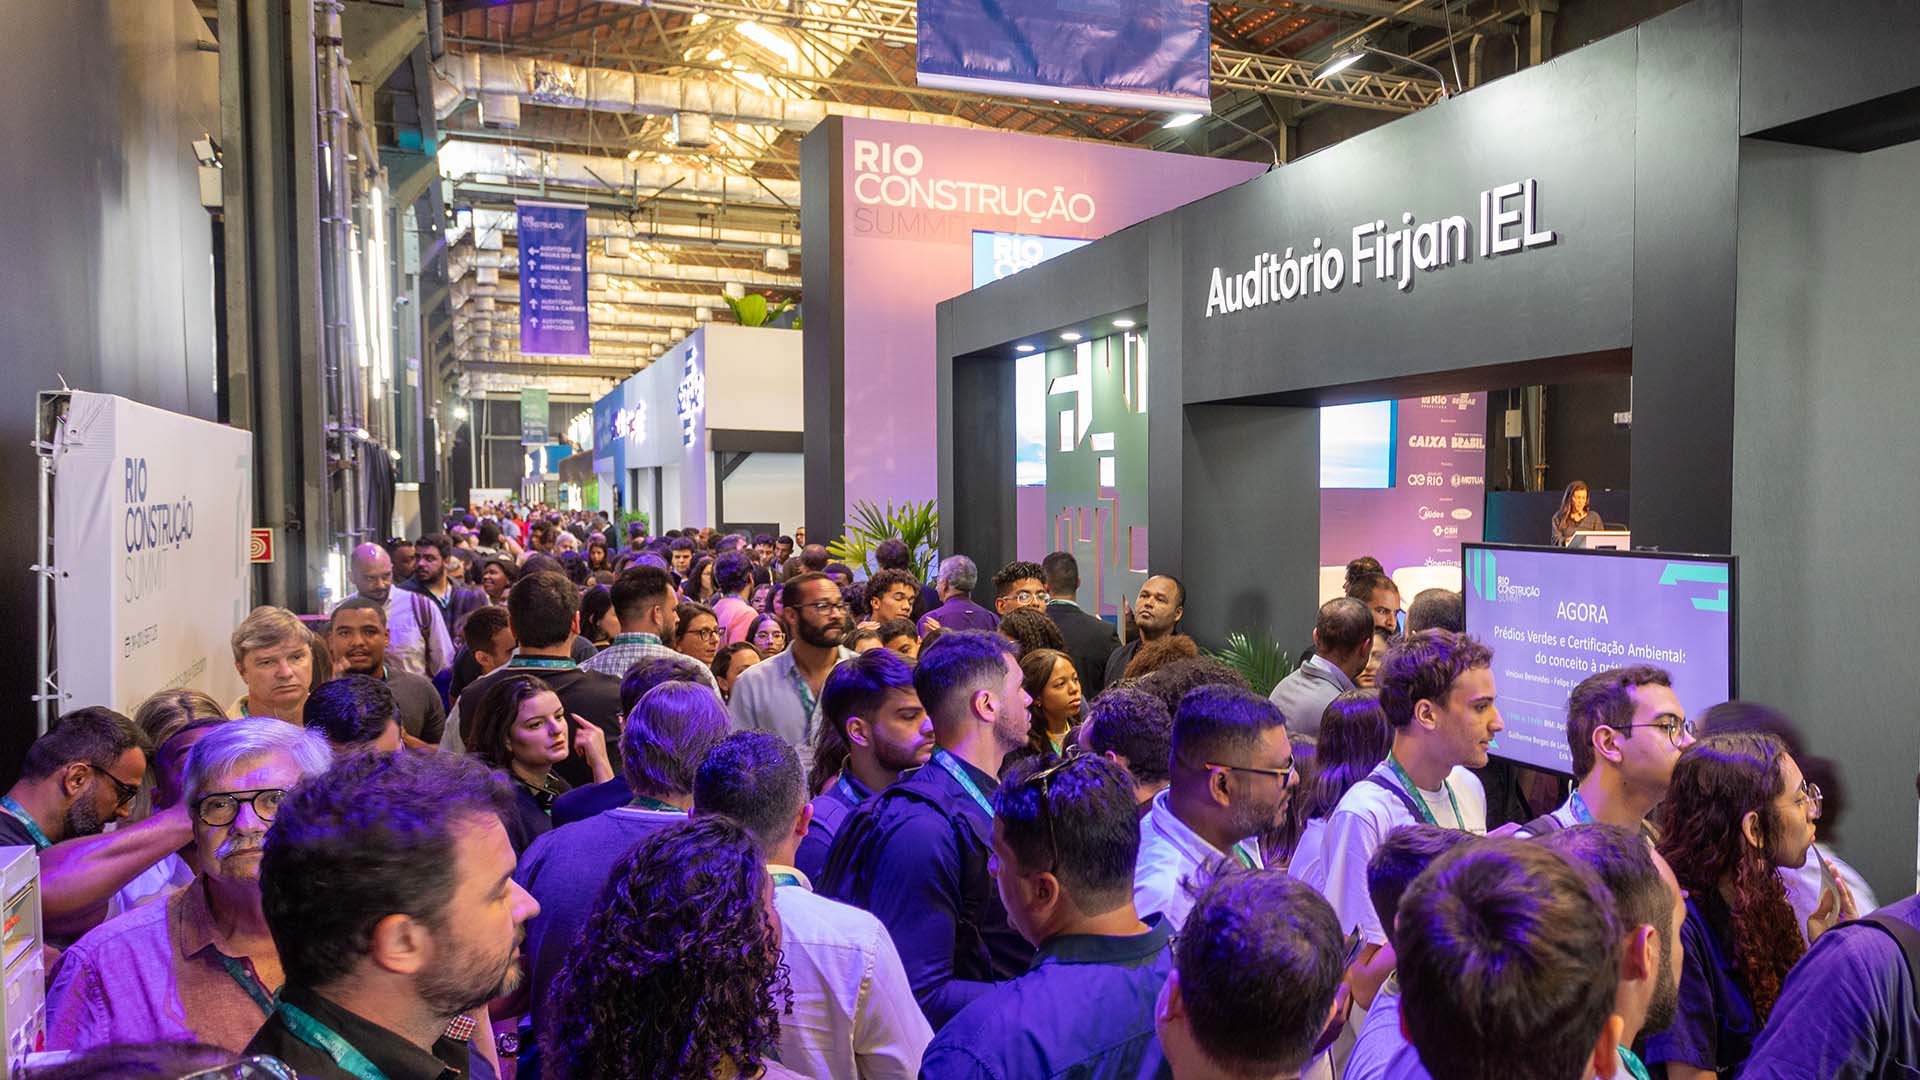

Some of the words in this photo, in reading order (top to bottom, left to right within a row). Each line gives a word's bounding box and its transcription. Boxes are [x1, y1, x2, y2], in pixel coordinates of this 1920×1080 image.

[854, 139, 924, 176] RIO
[854, 173, 1096, 224] CONSTRUÇÃO
[992, 237, 1045, 261] RIO
[1205, 237, 1346, 318] Auditório
[1352, 211, 1468, 291] Firjan
[1480, 178, 1556, 257] IEL
[1408, 435, 1447, 448] CAIXA
[1451, 436, 1486, 449] BRASIL
[125, 457, 147, 504] RIO
[1426, 476, 1444, 486] RIO
[125, 495, 193, 553] CONSTRUÇÃO
[1497, 575, 1510, 586] RIO
[1497, 584, 1541, 598] CONSTRUÇÃO
[1556, 601, 1609, 624] AGORA
[1494, 625, 1525, 642] Prédios
[1527, 630, 1557, 647] Verdes
[1559, 636, 1566, 648] e
[1567, 635, 1625, 657] Certificação
[1627, 643, 1686, 664] Ambiental:
[1535, 651, 1547, 665] do
[1548, 654, 1588, 673] conceito
